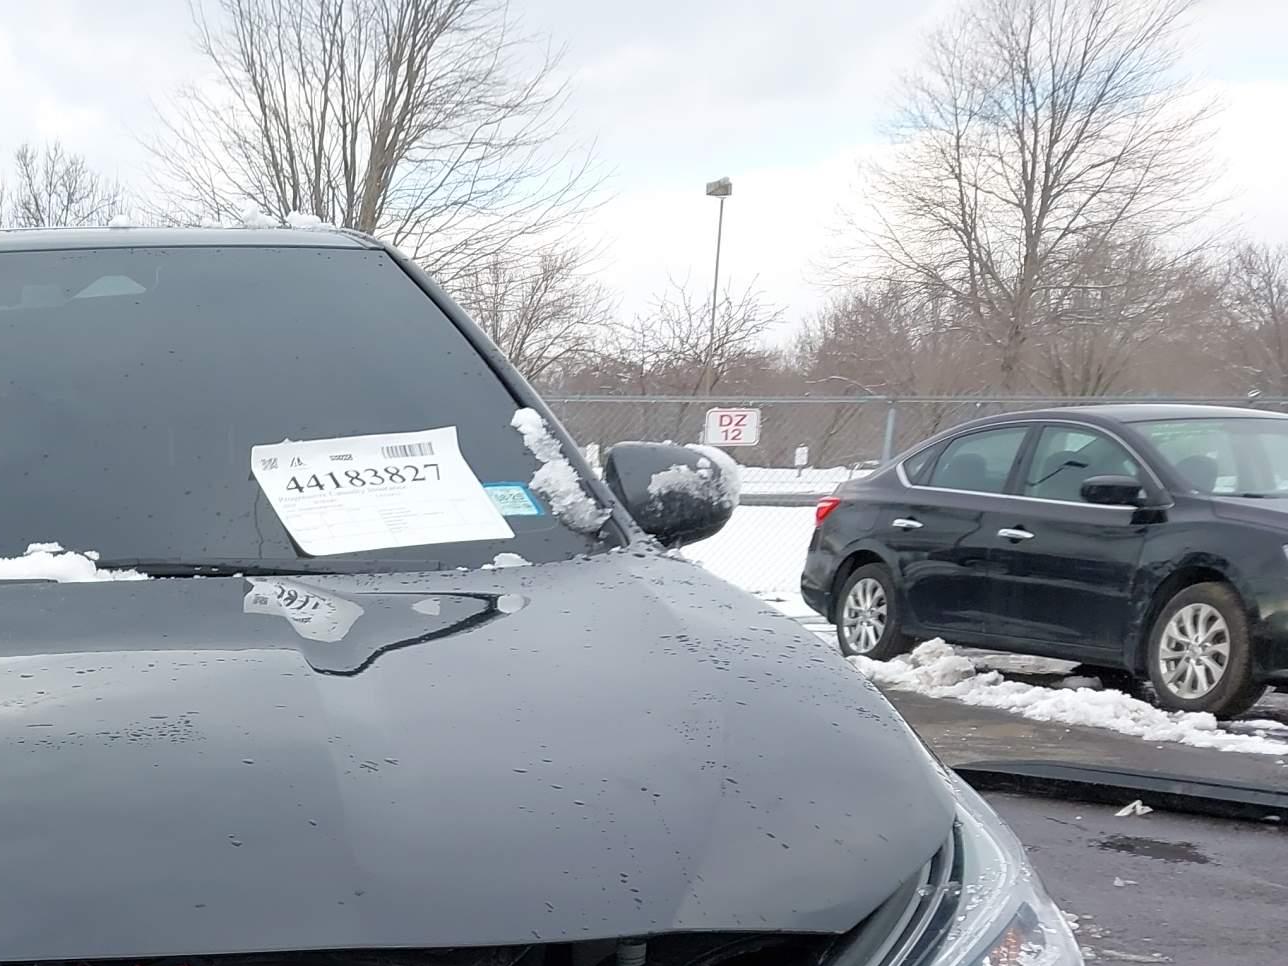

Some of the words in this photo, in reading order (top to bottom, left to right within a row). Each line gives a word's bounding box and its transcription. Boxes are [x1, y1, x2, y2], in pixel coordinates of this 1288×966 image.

[719, 414, 747, 427] DZ
[721, 428, 743, 441] 12
[286, 463, 441, 493] 44183827
